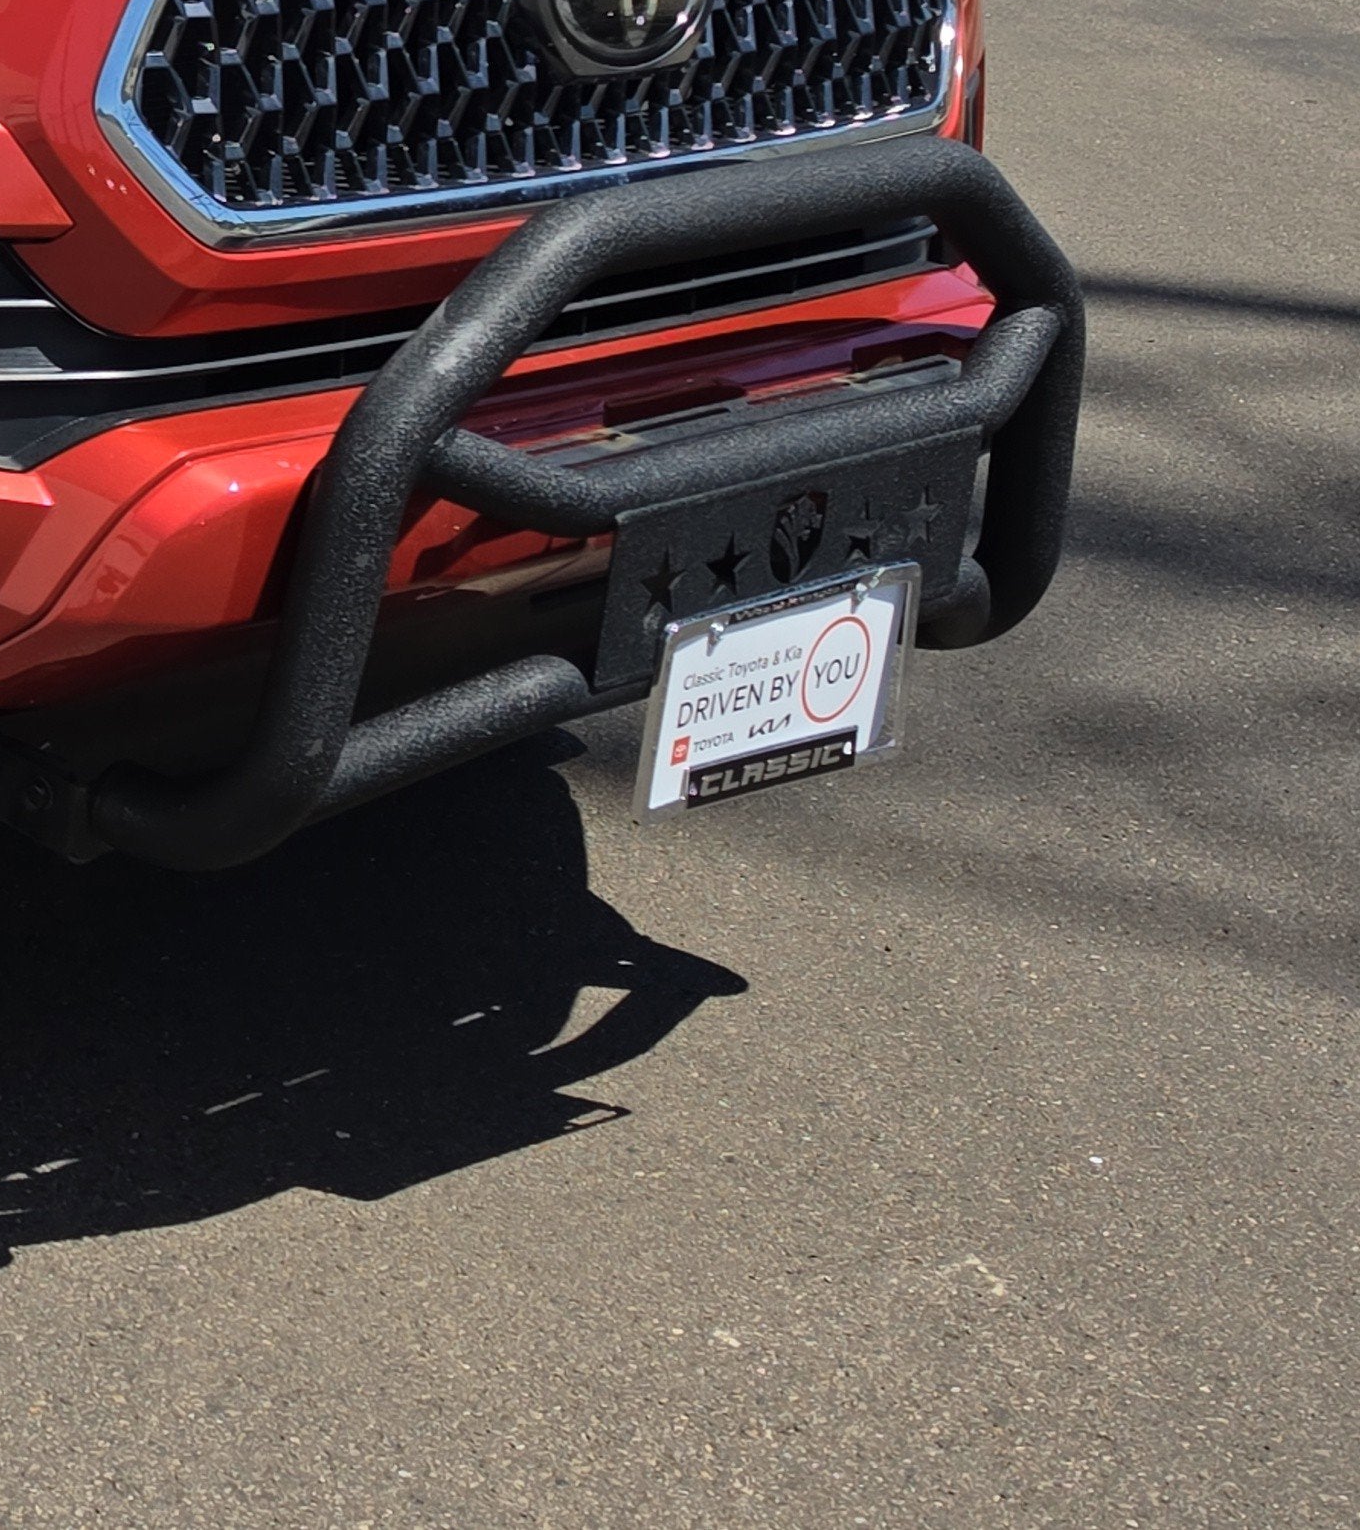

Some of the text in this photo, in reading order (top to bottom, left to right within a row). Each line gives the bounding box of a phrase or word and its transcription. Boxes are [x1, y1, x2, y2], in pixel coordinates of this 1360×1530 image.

[677, 653, 860, 729] DRIVEN BY YOU
[683, 645, 803, 691] Classic Toyota & Kia
[693, 732, 735, 753] TOYOTA
[701, 742, 842, 798] CLASSIC
